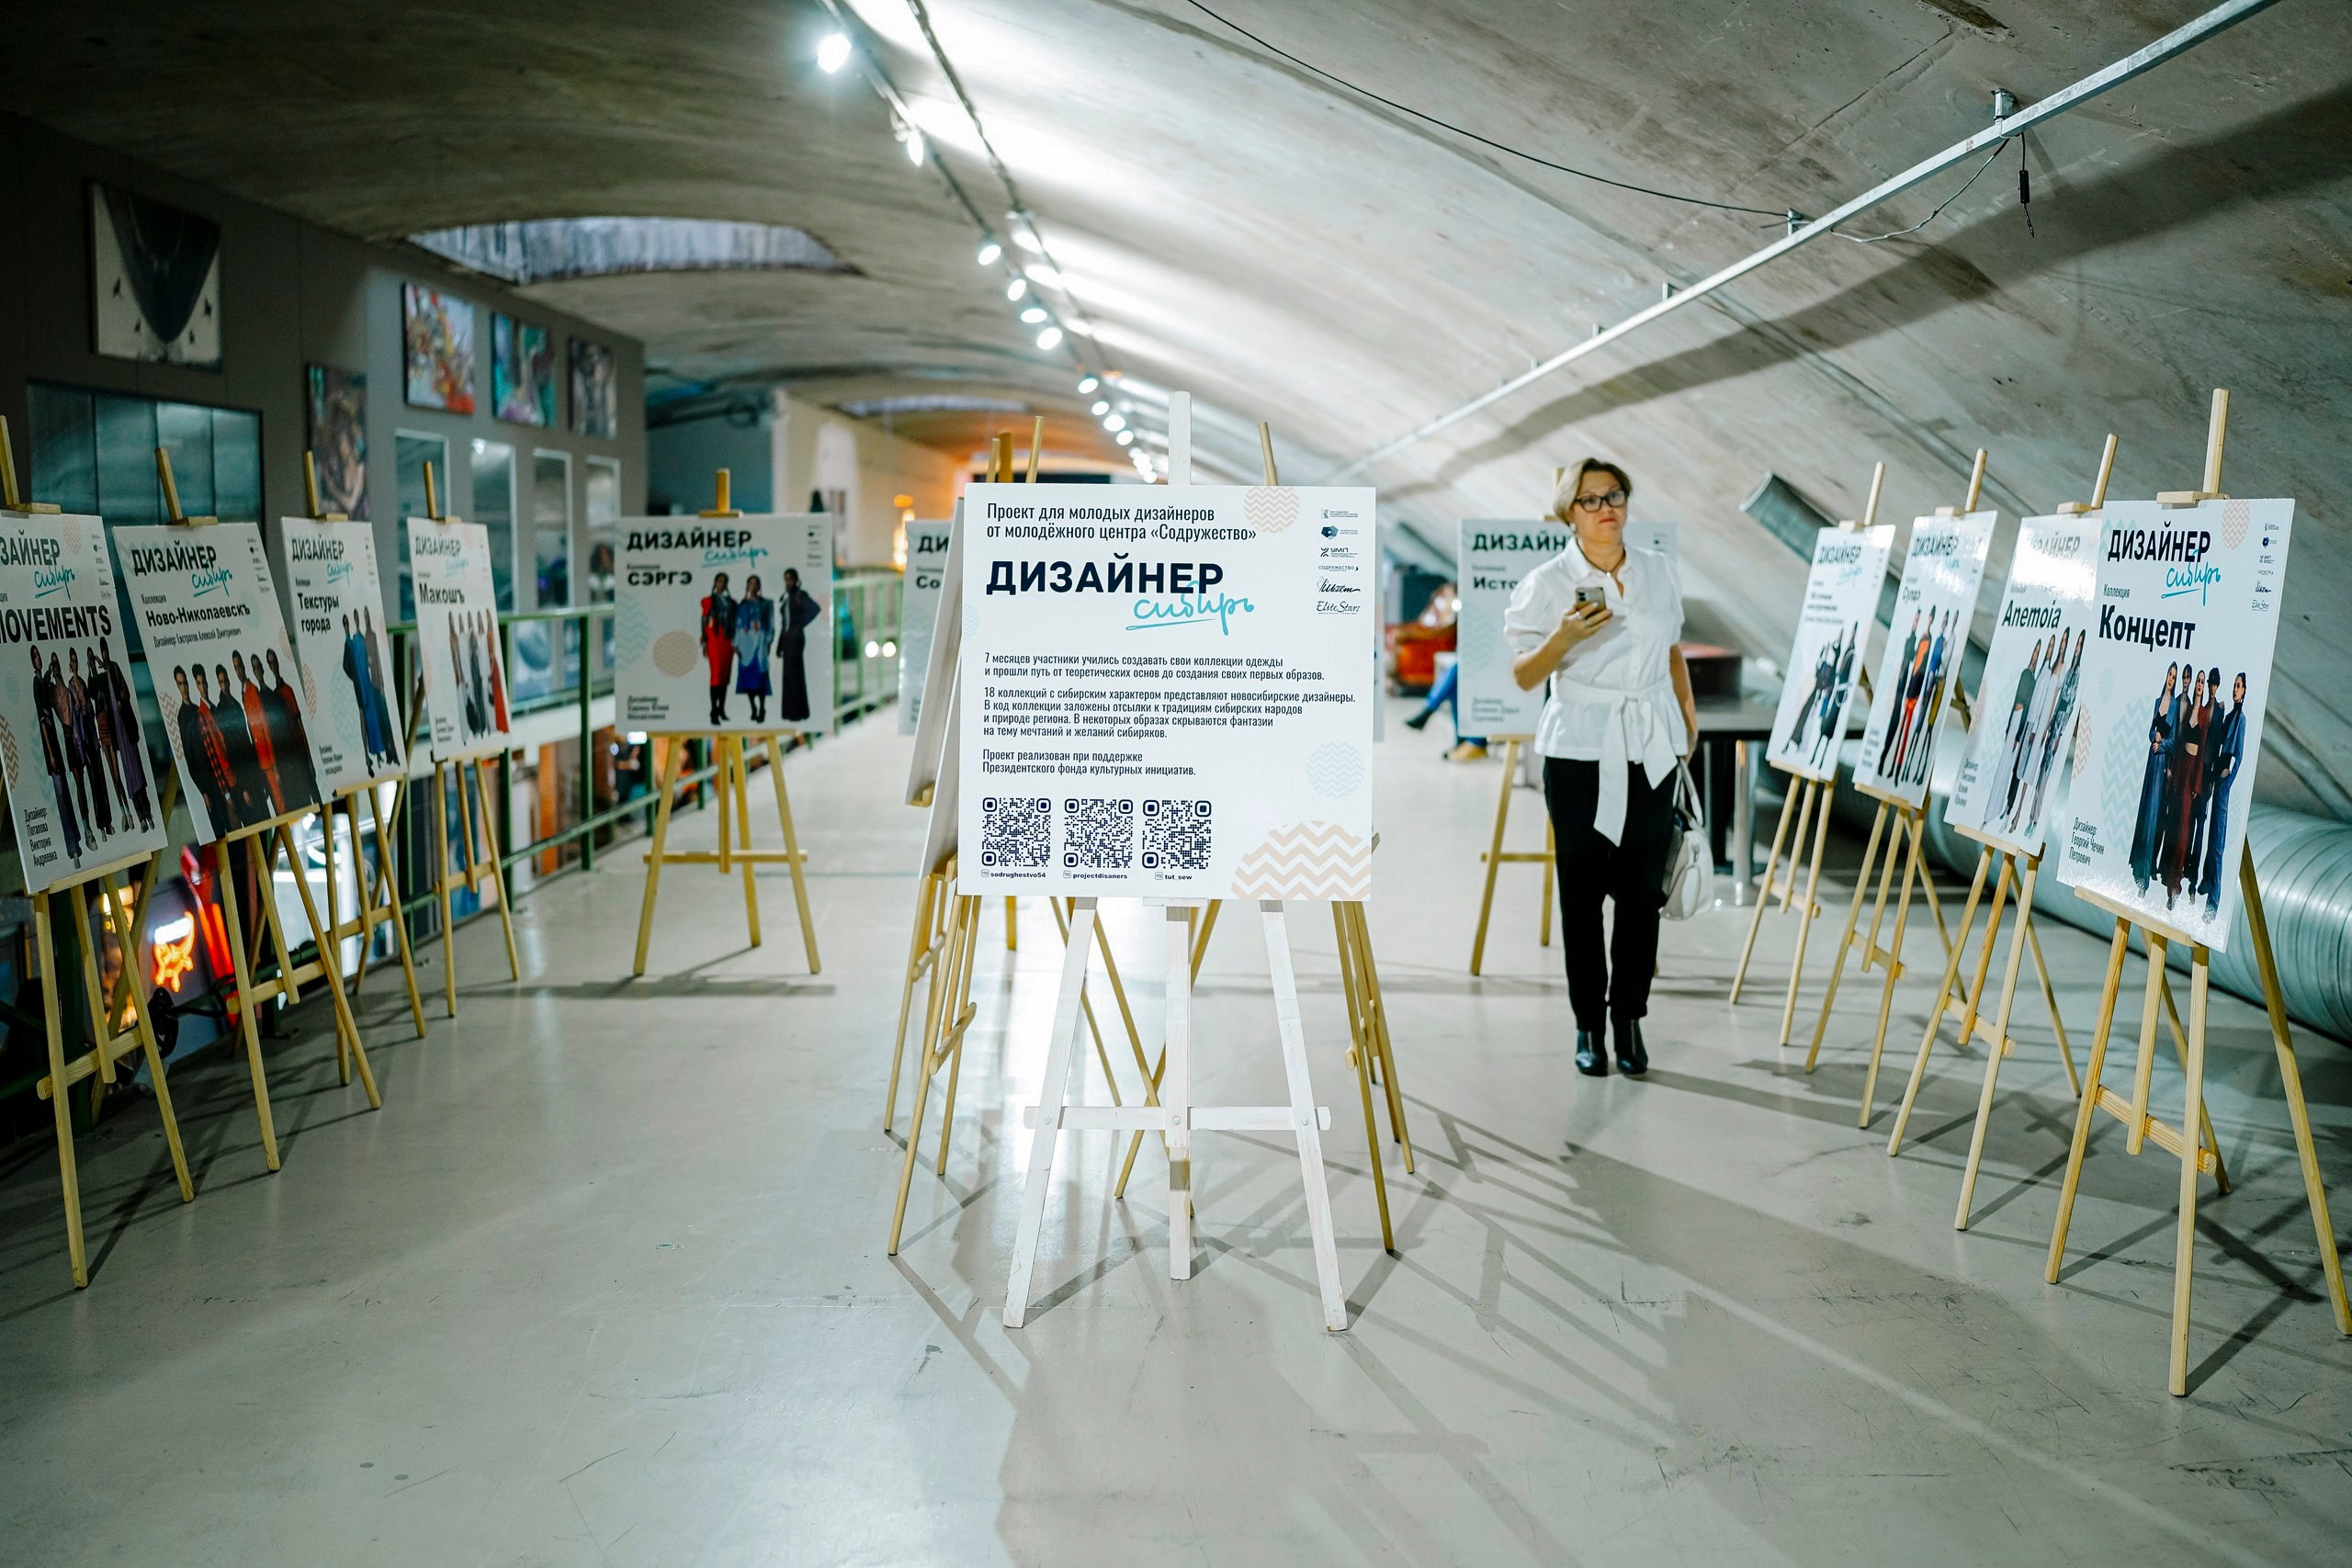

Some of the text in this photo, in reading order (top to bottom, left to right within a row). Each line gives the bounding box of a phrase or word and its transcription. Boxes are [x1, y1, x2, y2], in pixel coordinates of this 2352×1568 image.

[987, 502, 1216, 524] Проект для молодых дизайнеров
[627, 527, 752, 551] ДИЗАЙНЕР
[986, 522, 1257, 543] от молодёжного центра «Содружество»
[1472, 531, 1570, 551] ДИЗАЙН
[2108, 521, 2211, 563] ДИЗАЙНЕР
[130, 540, 217, 576] ДИЗАЙНЕР
[291, 534, 345, 562] ДИЗАЙНЕР
[628, 571, 693, 586] СЭРГЭ
[986, 553, 1224, 595] ДИЗАЙНЕР
[2103, 584, 2131, 599] Коллекция
[297, 592, 340, 613] Текстуры
[1132, 581, 1255, 636] сибирь
[145, 603, 251, 627] Ново-Николаевскъ
[2001, 600, 2062, 628] Anemoia
[301, 617, 331, 636] города
[2098, 604, 2196, 652] Концепт
[984, 651, 1283, 668] 7 месяцев участники учились создавать свои коллекции одежды
[984, 667, 1325, 682] и прошли путь от теоретических основ до создания своих первых образов.
[984, 686, 1356, 704] 18 коллекций с сибирским характером представляют новосибирские дизайнеры.
[984, 699, 1303, 716] В код коллекции заложены отсылки к традициям сибирских народов
[983, 713, 1273, 728] и природе региона. В некоторых образах скрываются фантазии
[983, 726, 1168, 739] на тему мечтаний и желаний сибиряков.
[982, 748, 1143, 763] Проект реализован при поддержке
[982, 761, 1196, 776] Президентского фонда культурных инициатив.
